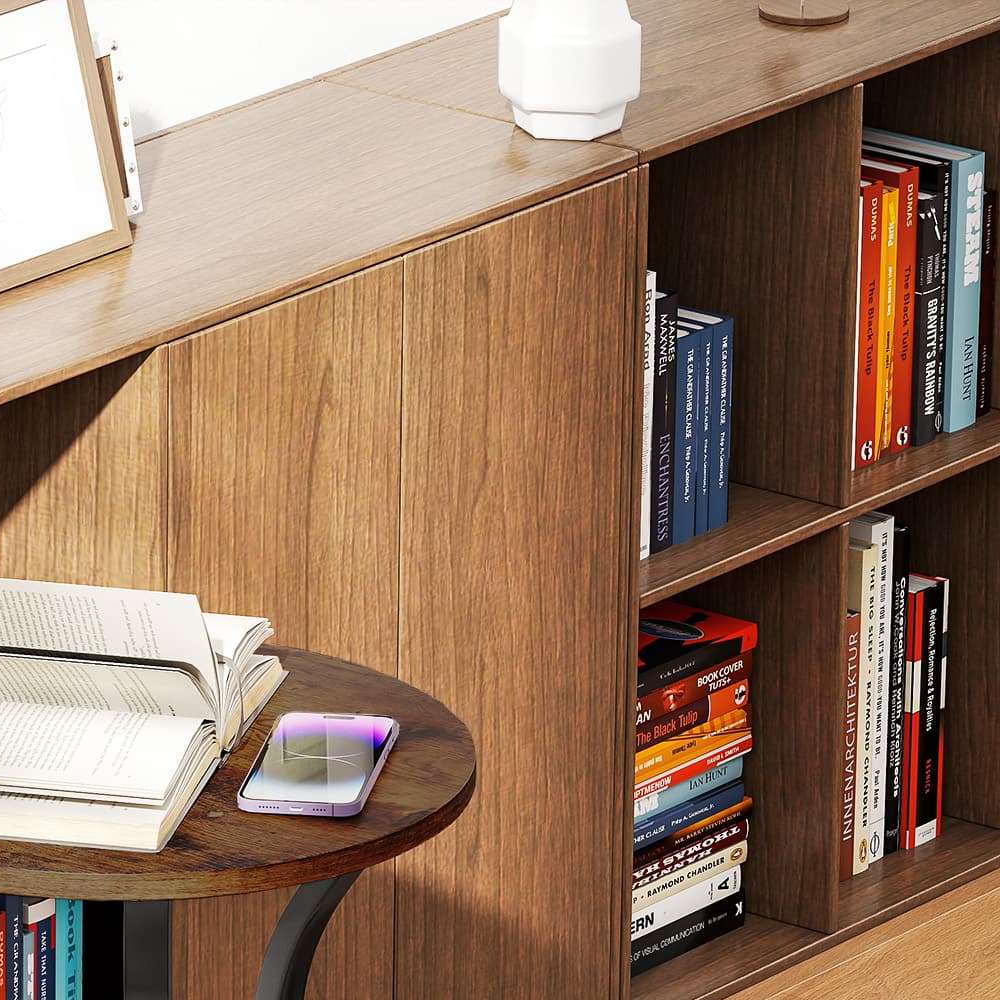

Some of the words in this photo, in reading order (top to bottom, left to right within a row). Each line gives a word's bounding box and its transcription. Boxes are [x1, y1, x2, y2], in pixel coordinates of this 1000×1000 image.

[870, 198, 878, 241] DUMAS
[964, 171, 982, 286] STEAM
[658, 314, 668, 376] MAXWELL
[668, 319, 676, 362] JAMES
[866, 308, 874, 342] Black
[926, 298, 938, 359] GRAVITY'S
[865, 344, 873, 376] Tulip
[964, 336, 975, 361] IAN
[686, 364, 694, 411] GRANDFATHER
[924, 362, 936, 416] RAINBOW
[962, 364, 974, 401] HUNT
[657, 433, 670, 542] ENCHANTRESS
[897, 577, 906, 684] Conversations
[928, 608, 937, 650] Rejection,
[698, 670, 719, 688] BOOK
[719, 660, 743, 678] COVER
[709, 677, 731, 692] TUTS+
[927, 651, 936, 686] Romance
[636, 730, 652, 747] The
[653, 720, 676, 739] Black
[679, 710, 698, 728] Tulip
[864, 681, 872, 751] RAYMOND
[890, 689, 898, 738] Heinrich
[925, 696, 934, 732] Royalties
[725, 746, 739, 758] SMITH
[843, 632, 859, 842] INNENARCHITEKTUR
[875, 735, 881, 744] TO
[889, 740, 897, 768] Klotz
[689, 776, 704, 791] IAN
[705, 766, 728, 785] HUNT
[893, 725, 902, 798] Architects
[645, 825, 665, 840] CLAUSE
[663, 825, 741, 866] THOMAS
[647, 876, 685, 898] RAYMOND
[687, 856, 725, 883] CHANDLER
[642, 942, 660, 959] VISUAL
[660, 921, 705, 948] COMMUNICATION
